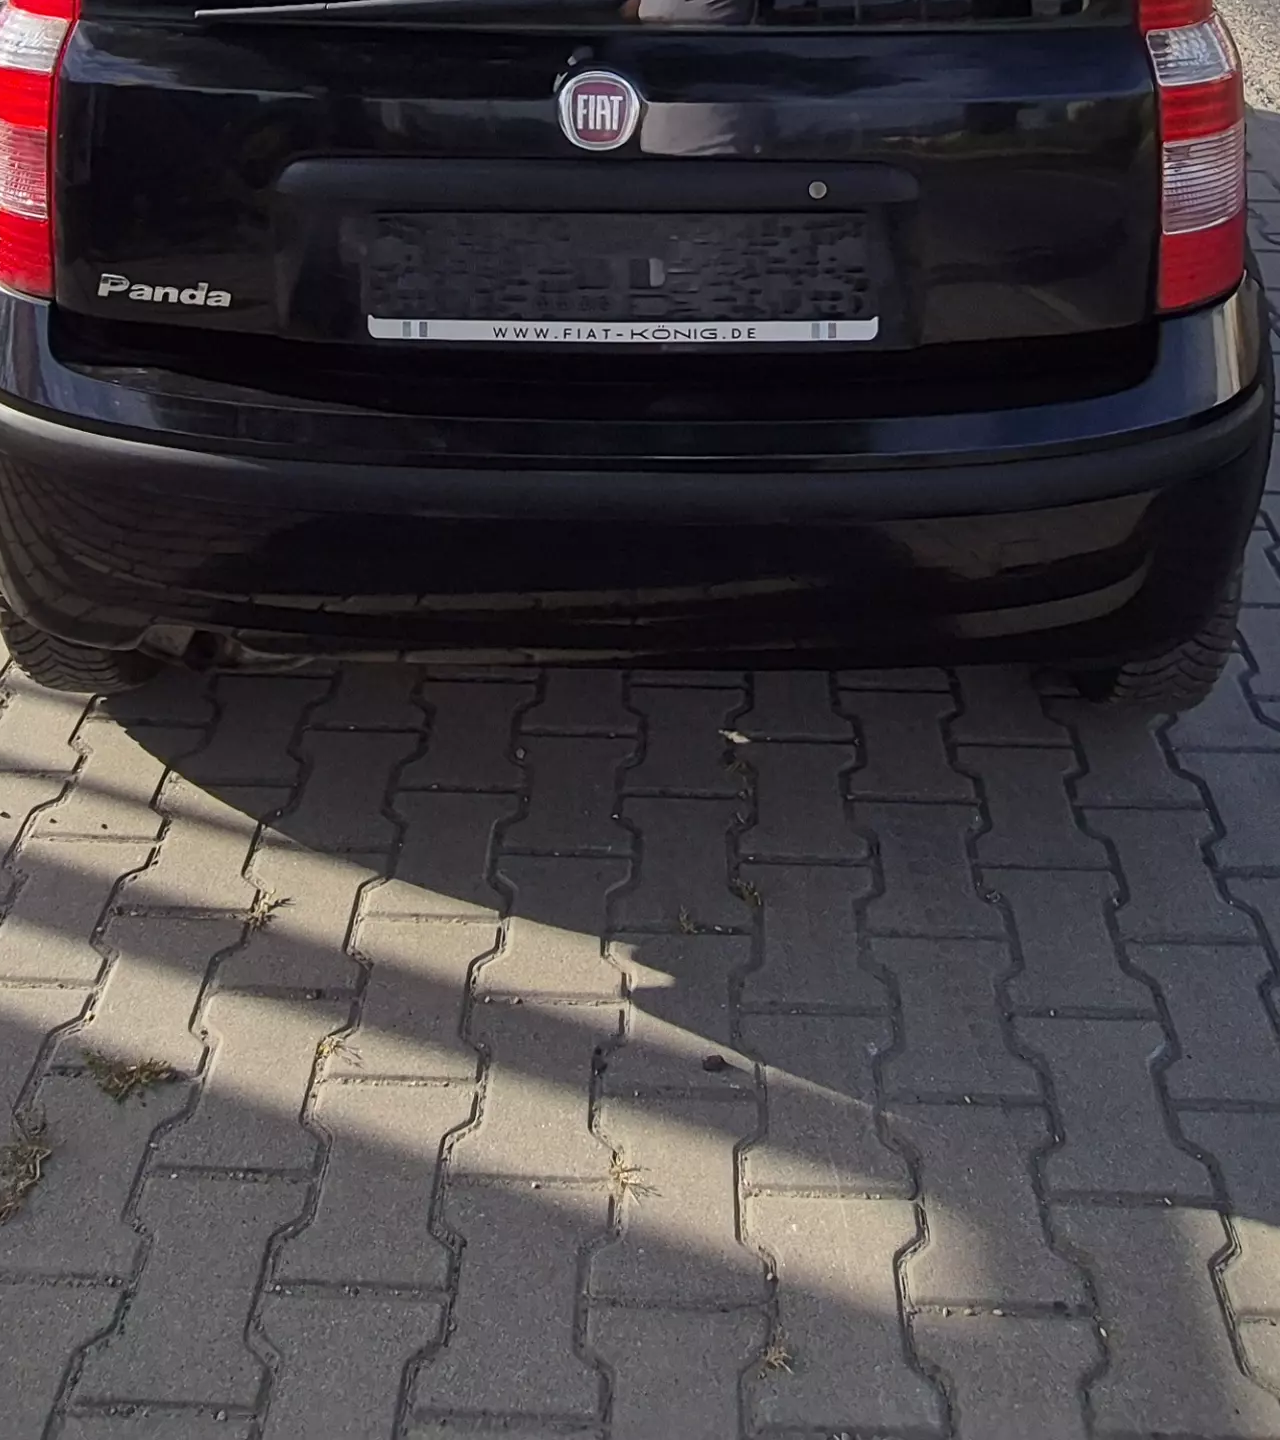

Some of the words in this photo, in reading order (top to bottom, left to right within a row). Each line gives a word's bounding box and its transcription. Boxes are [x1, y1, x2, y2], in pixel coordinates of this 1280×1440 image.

[577, 94, 624, 131] FIAT
[97, 273, 232, 308] Panda
[493, 325, 757, 341] WWW.FIAT-KÖNIG.DE
